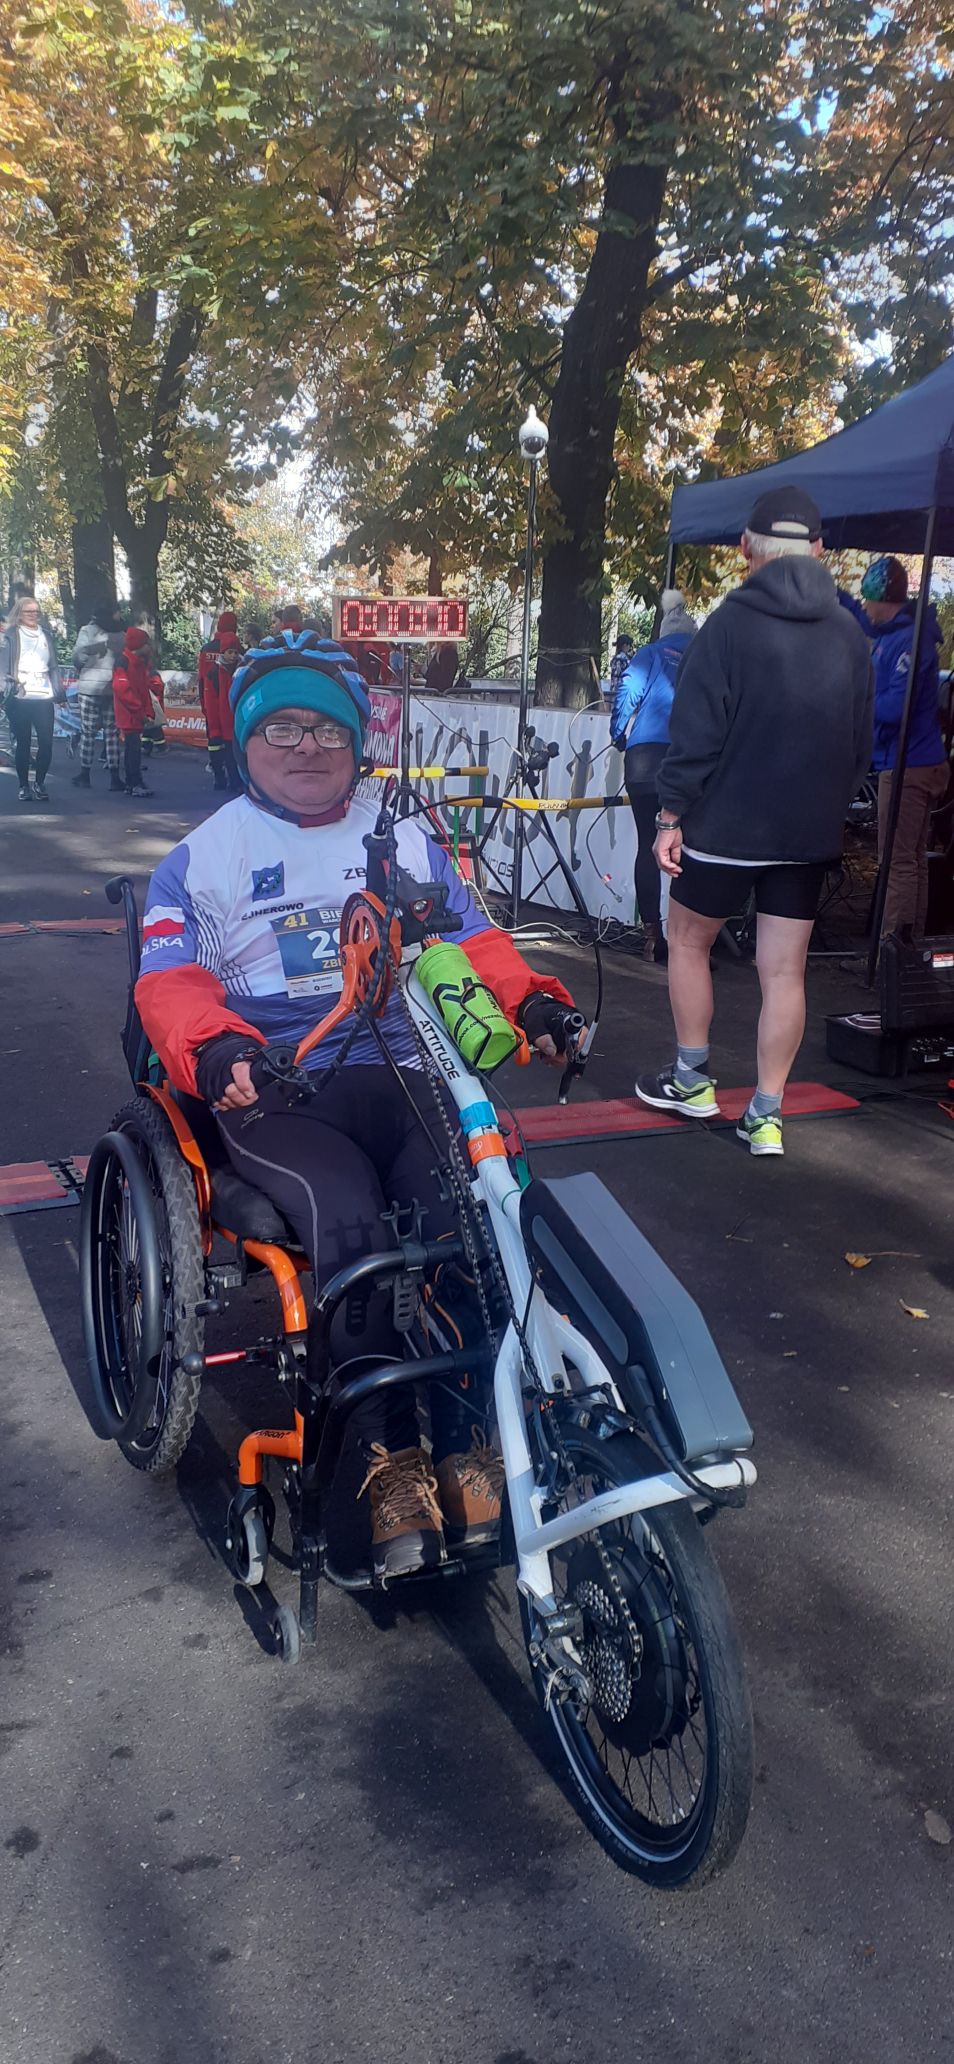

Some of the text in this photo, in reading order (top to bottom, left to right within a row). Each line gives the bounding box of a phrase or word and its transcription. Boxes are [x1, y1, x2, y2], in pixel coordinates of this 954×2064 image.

[283, 912, 309, 928] 41
[319, 910, 343, 920] BIE
[418, 1020, 460, 1081] ATTITUDE
